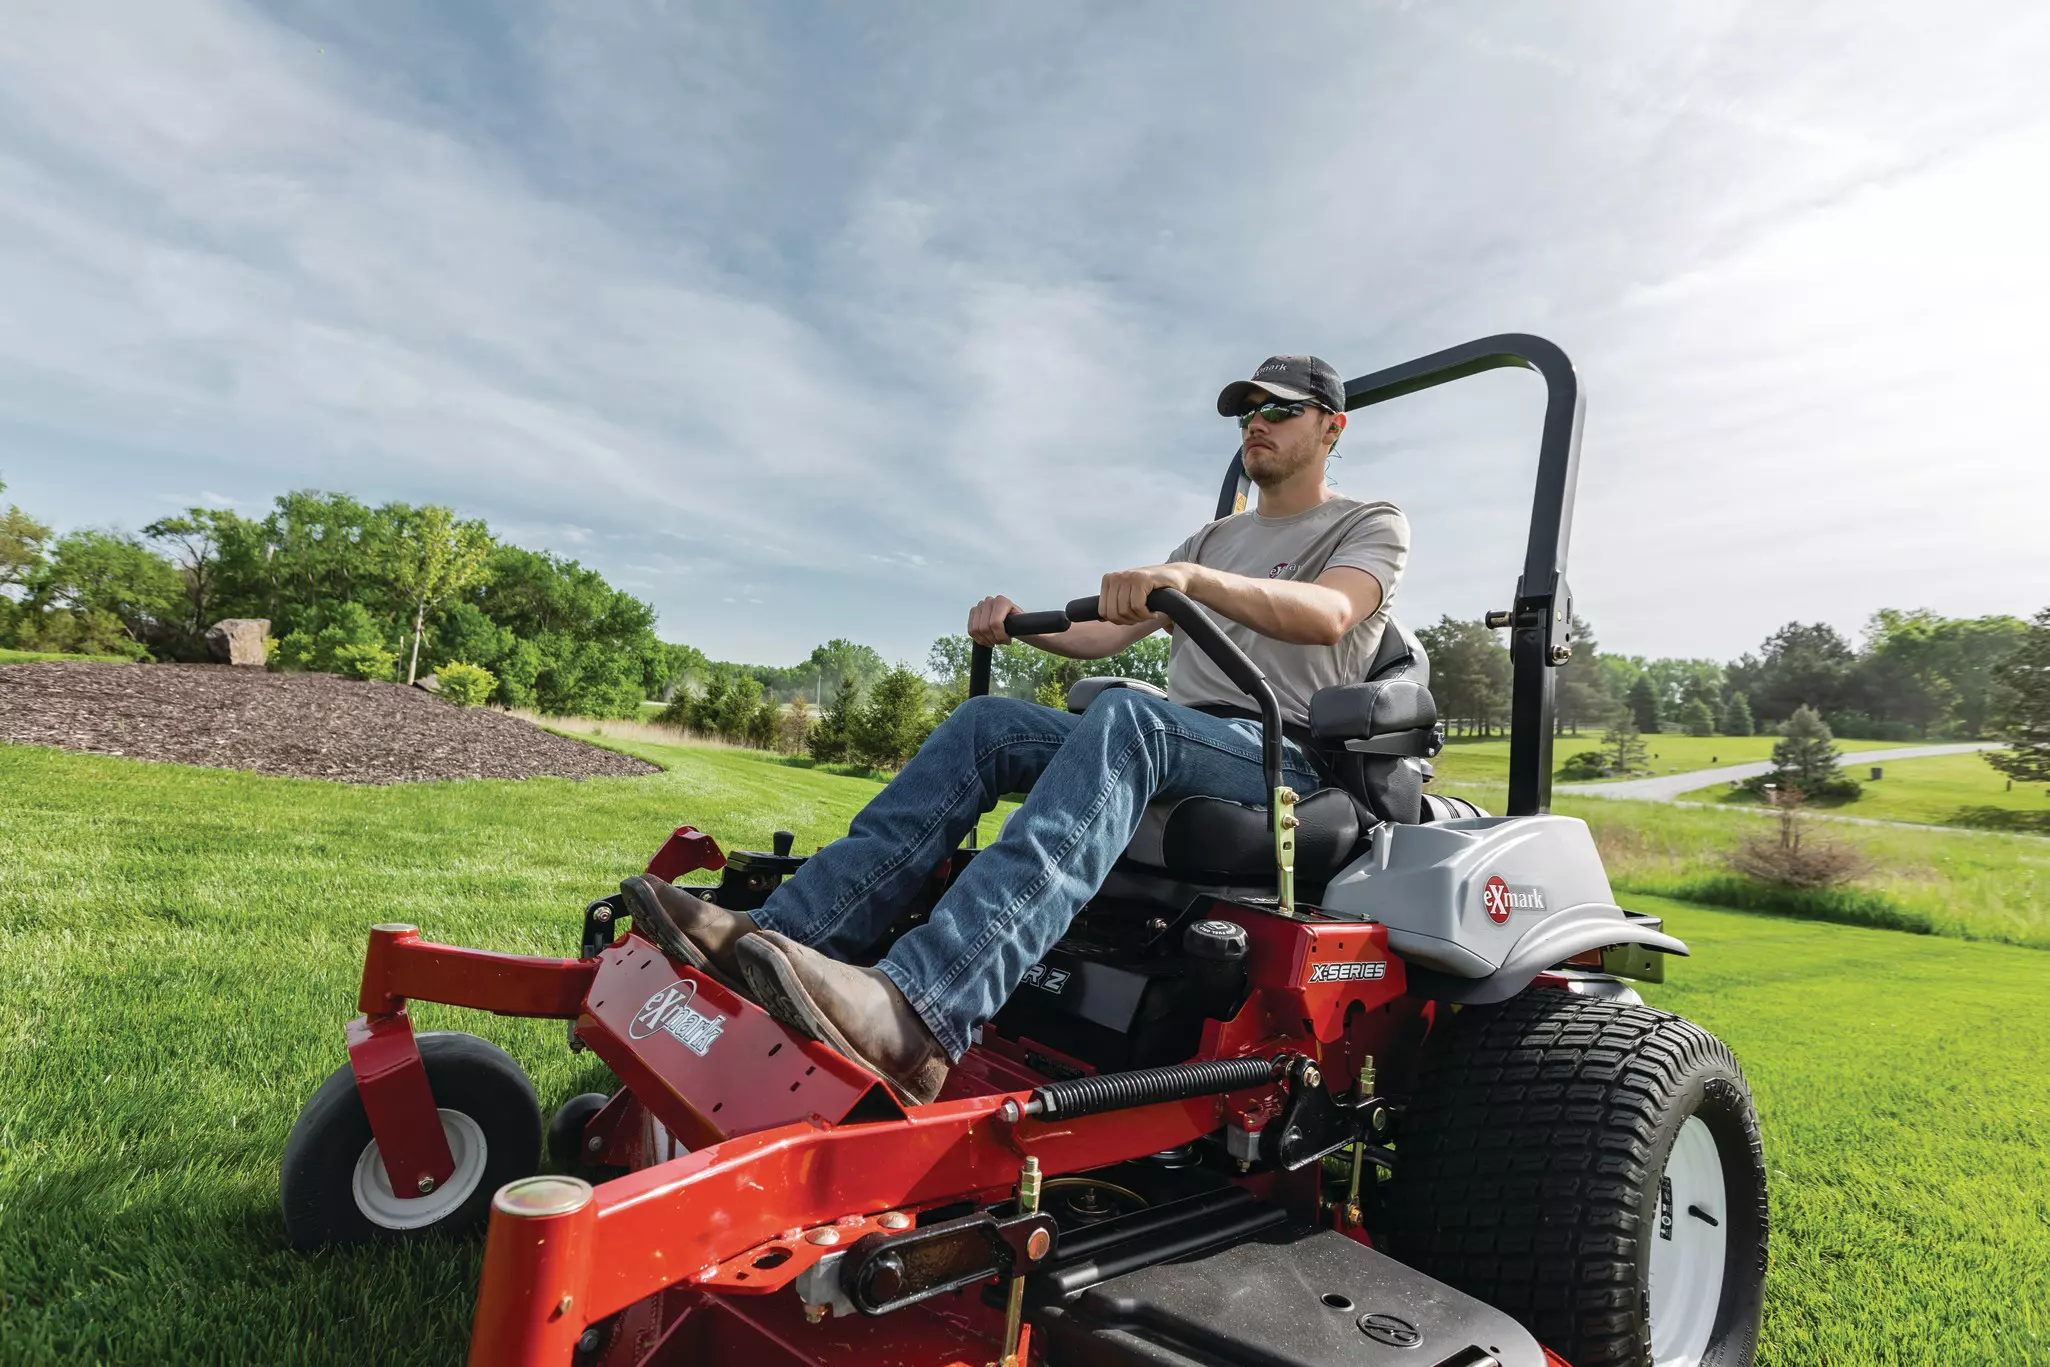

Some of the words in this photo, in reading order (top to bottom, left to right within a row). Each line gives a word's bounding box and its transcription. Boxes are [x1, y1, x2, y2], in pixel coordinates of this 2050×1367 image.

[1483, 884, 1545, 915] eXmark
[1309, 960, 1386, 983] X-SERIES
[635, 985, 726, 1055] eXmark
